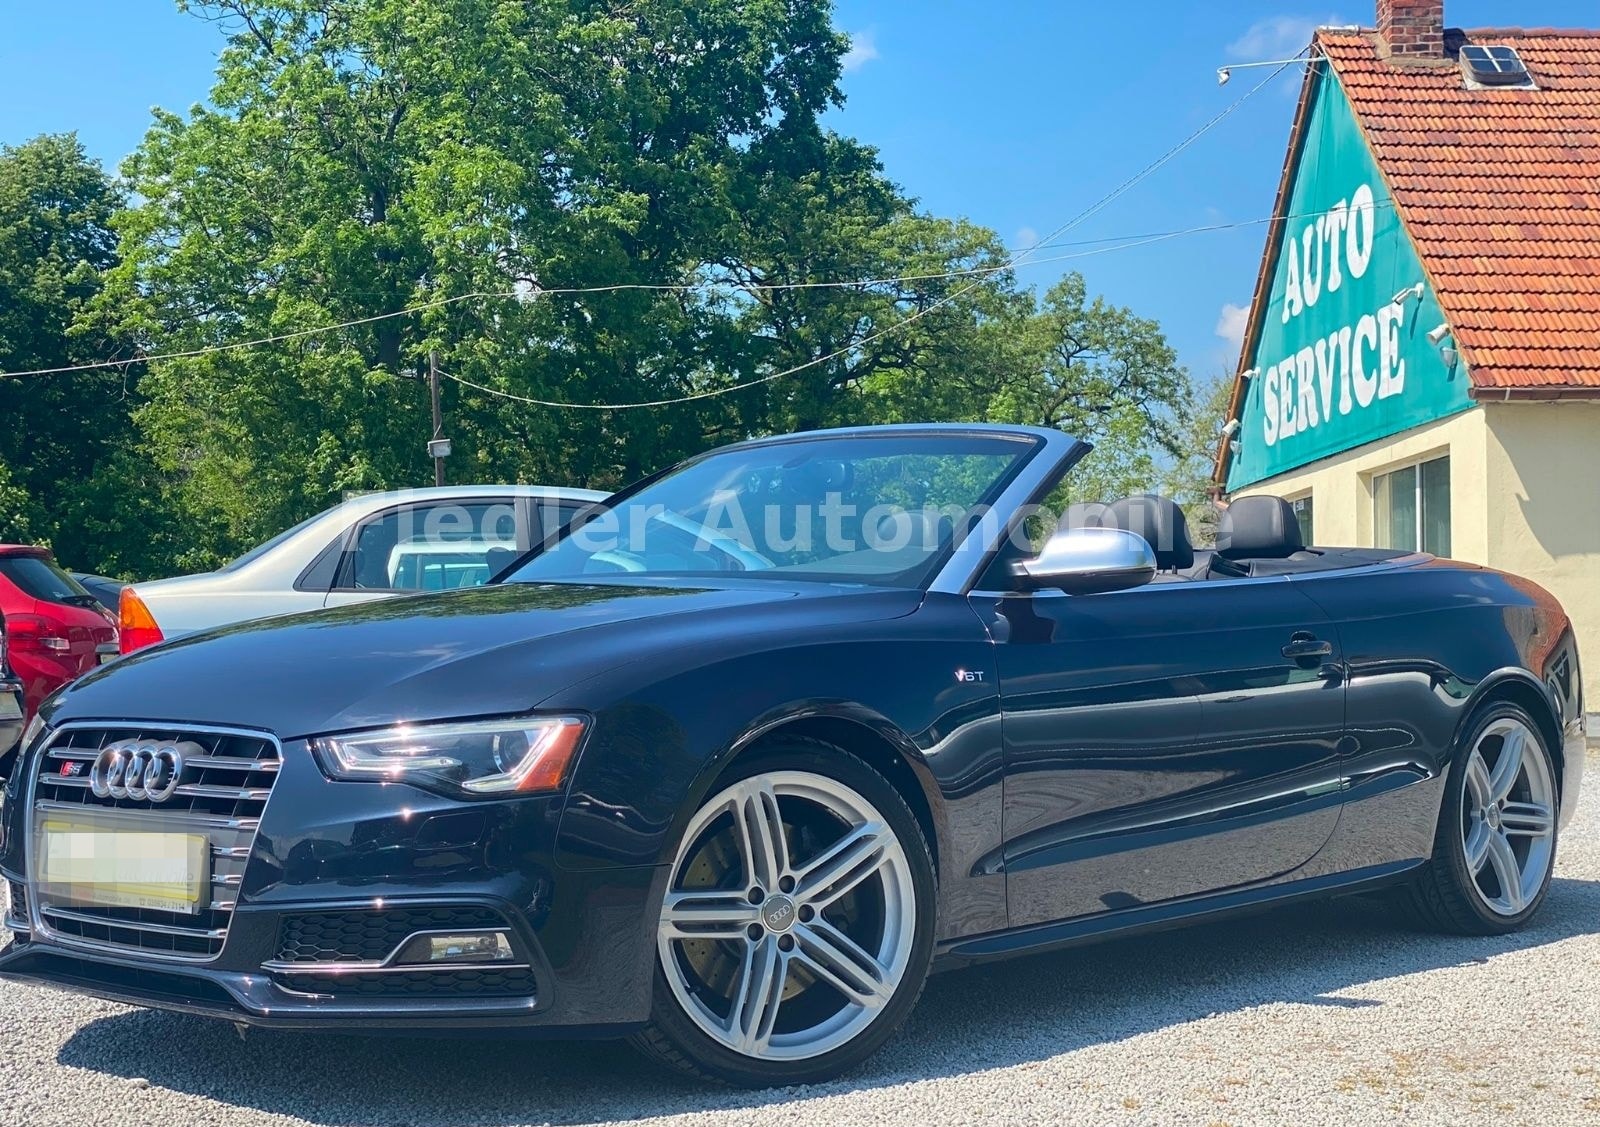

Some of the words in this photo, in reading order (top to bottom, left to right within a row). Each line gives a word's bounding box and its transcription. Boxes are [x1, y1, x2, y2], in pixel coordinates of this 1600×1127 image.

[1282, 184, 1374, 323] AUTO
[1263, 302, 1405, 446] SERVICE
[954, 669, 984, 682] V6T
